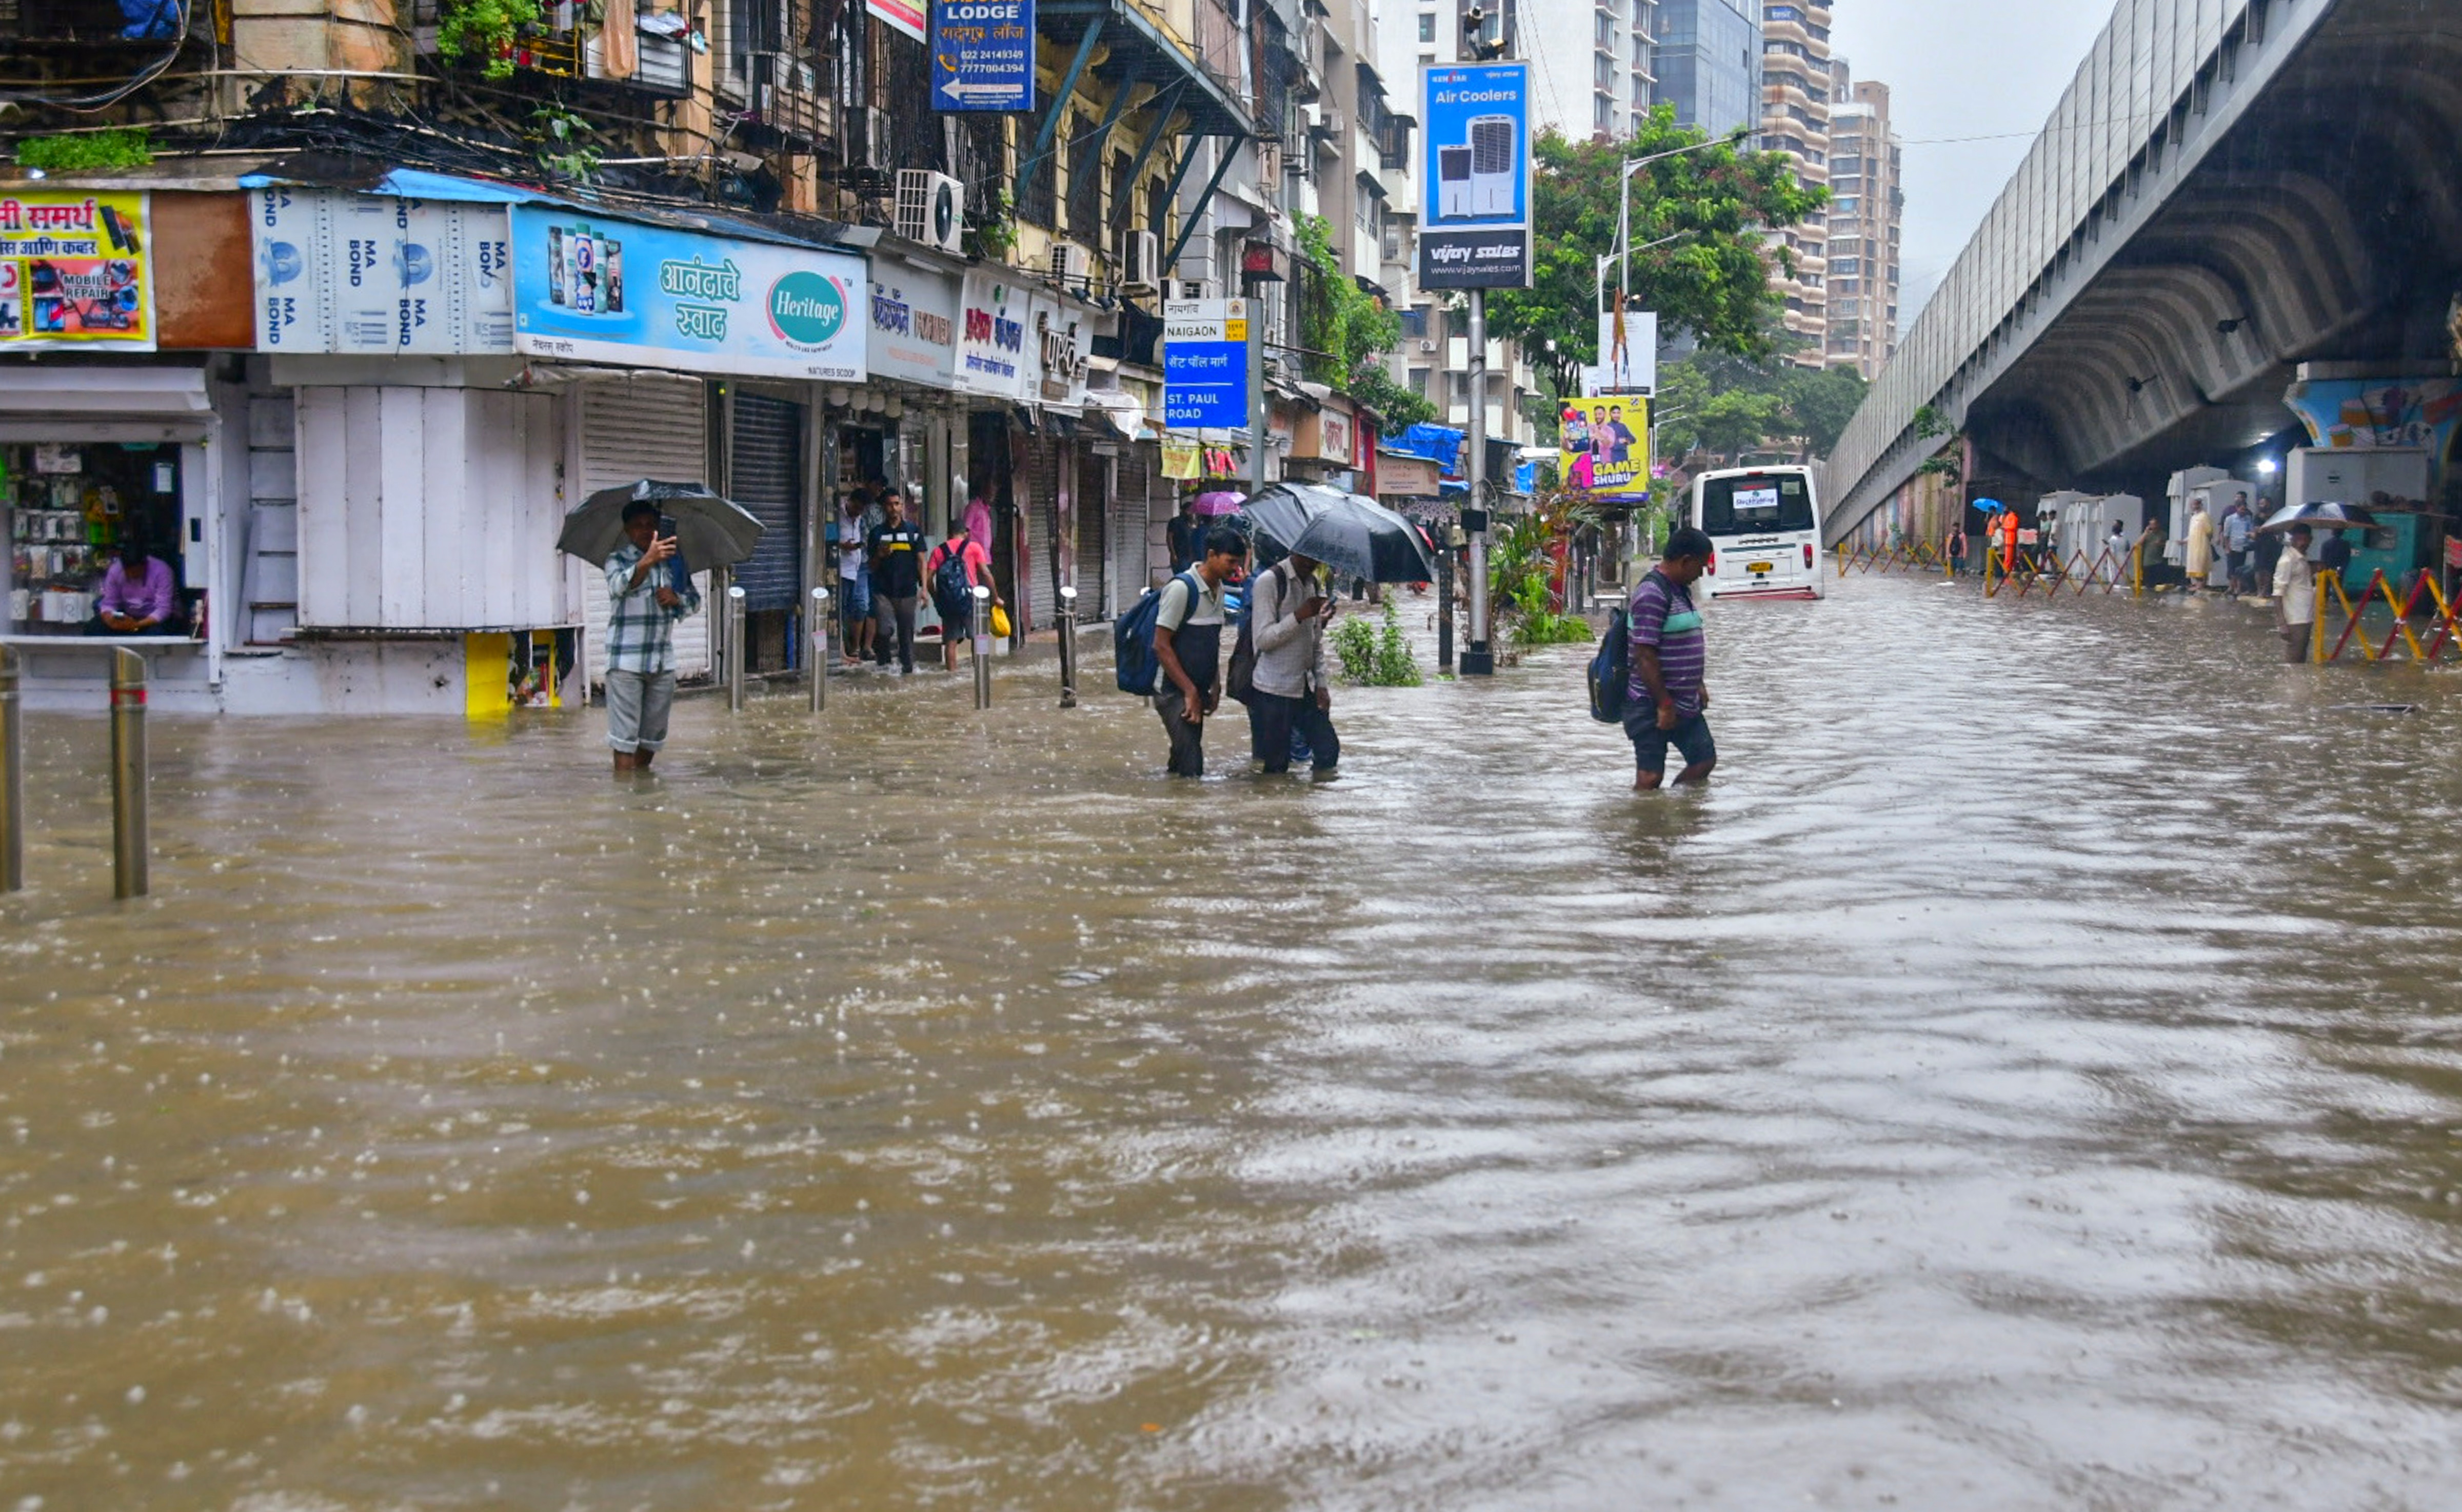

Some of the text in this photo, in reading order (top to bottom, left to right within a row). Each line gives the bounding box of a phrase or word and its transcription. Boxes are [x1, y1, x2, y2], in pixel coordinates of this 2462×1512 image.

[947, 6, 1019, 19] LODGE
[1436, 89, 1517, 103] Air Coolers
[28, 199, 94, 230] समर्थ
[264, 189, 277, 227] OND
[349, 240, 361, 287] BOND
[365, 240, 376, 268] MA
[494, 242, 506, 269] MA
[1431, 244, 1521, 263] vijay sales
[64, 275, 111, 285] MOBILE
[661, 257, 740, 301] आनंदाचे
[1431, 264, 1521, 275] www.vijaysales.com
[65, 289, 111, 299] REPAIR
[284, 297, 296, 326] MA
[415, 299, 426, 327] MA
[777, 290, 839, 327] Heritage
[268, 297, 281, 344] BOND
[399, 299, 411, 346] BOND
[677, 303, 727, 343] स्वाद
[1167, 326, 1217, 337] NAIGAON
[1209, 353, 1228, 368] मार्ग
[1167, 393, 1219, 404] ST. PAUL
[1168, 409, 1202, 419] ROAD
[1593, 460, 1641, 475] GAME
[1594, 473, 1631, 485] SHURU
